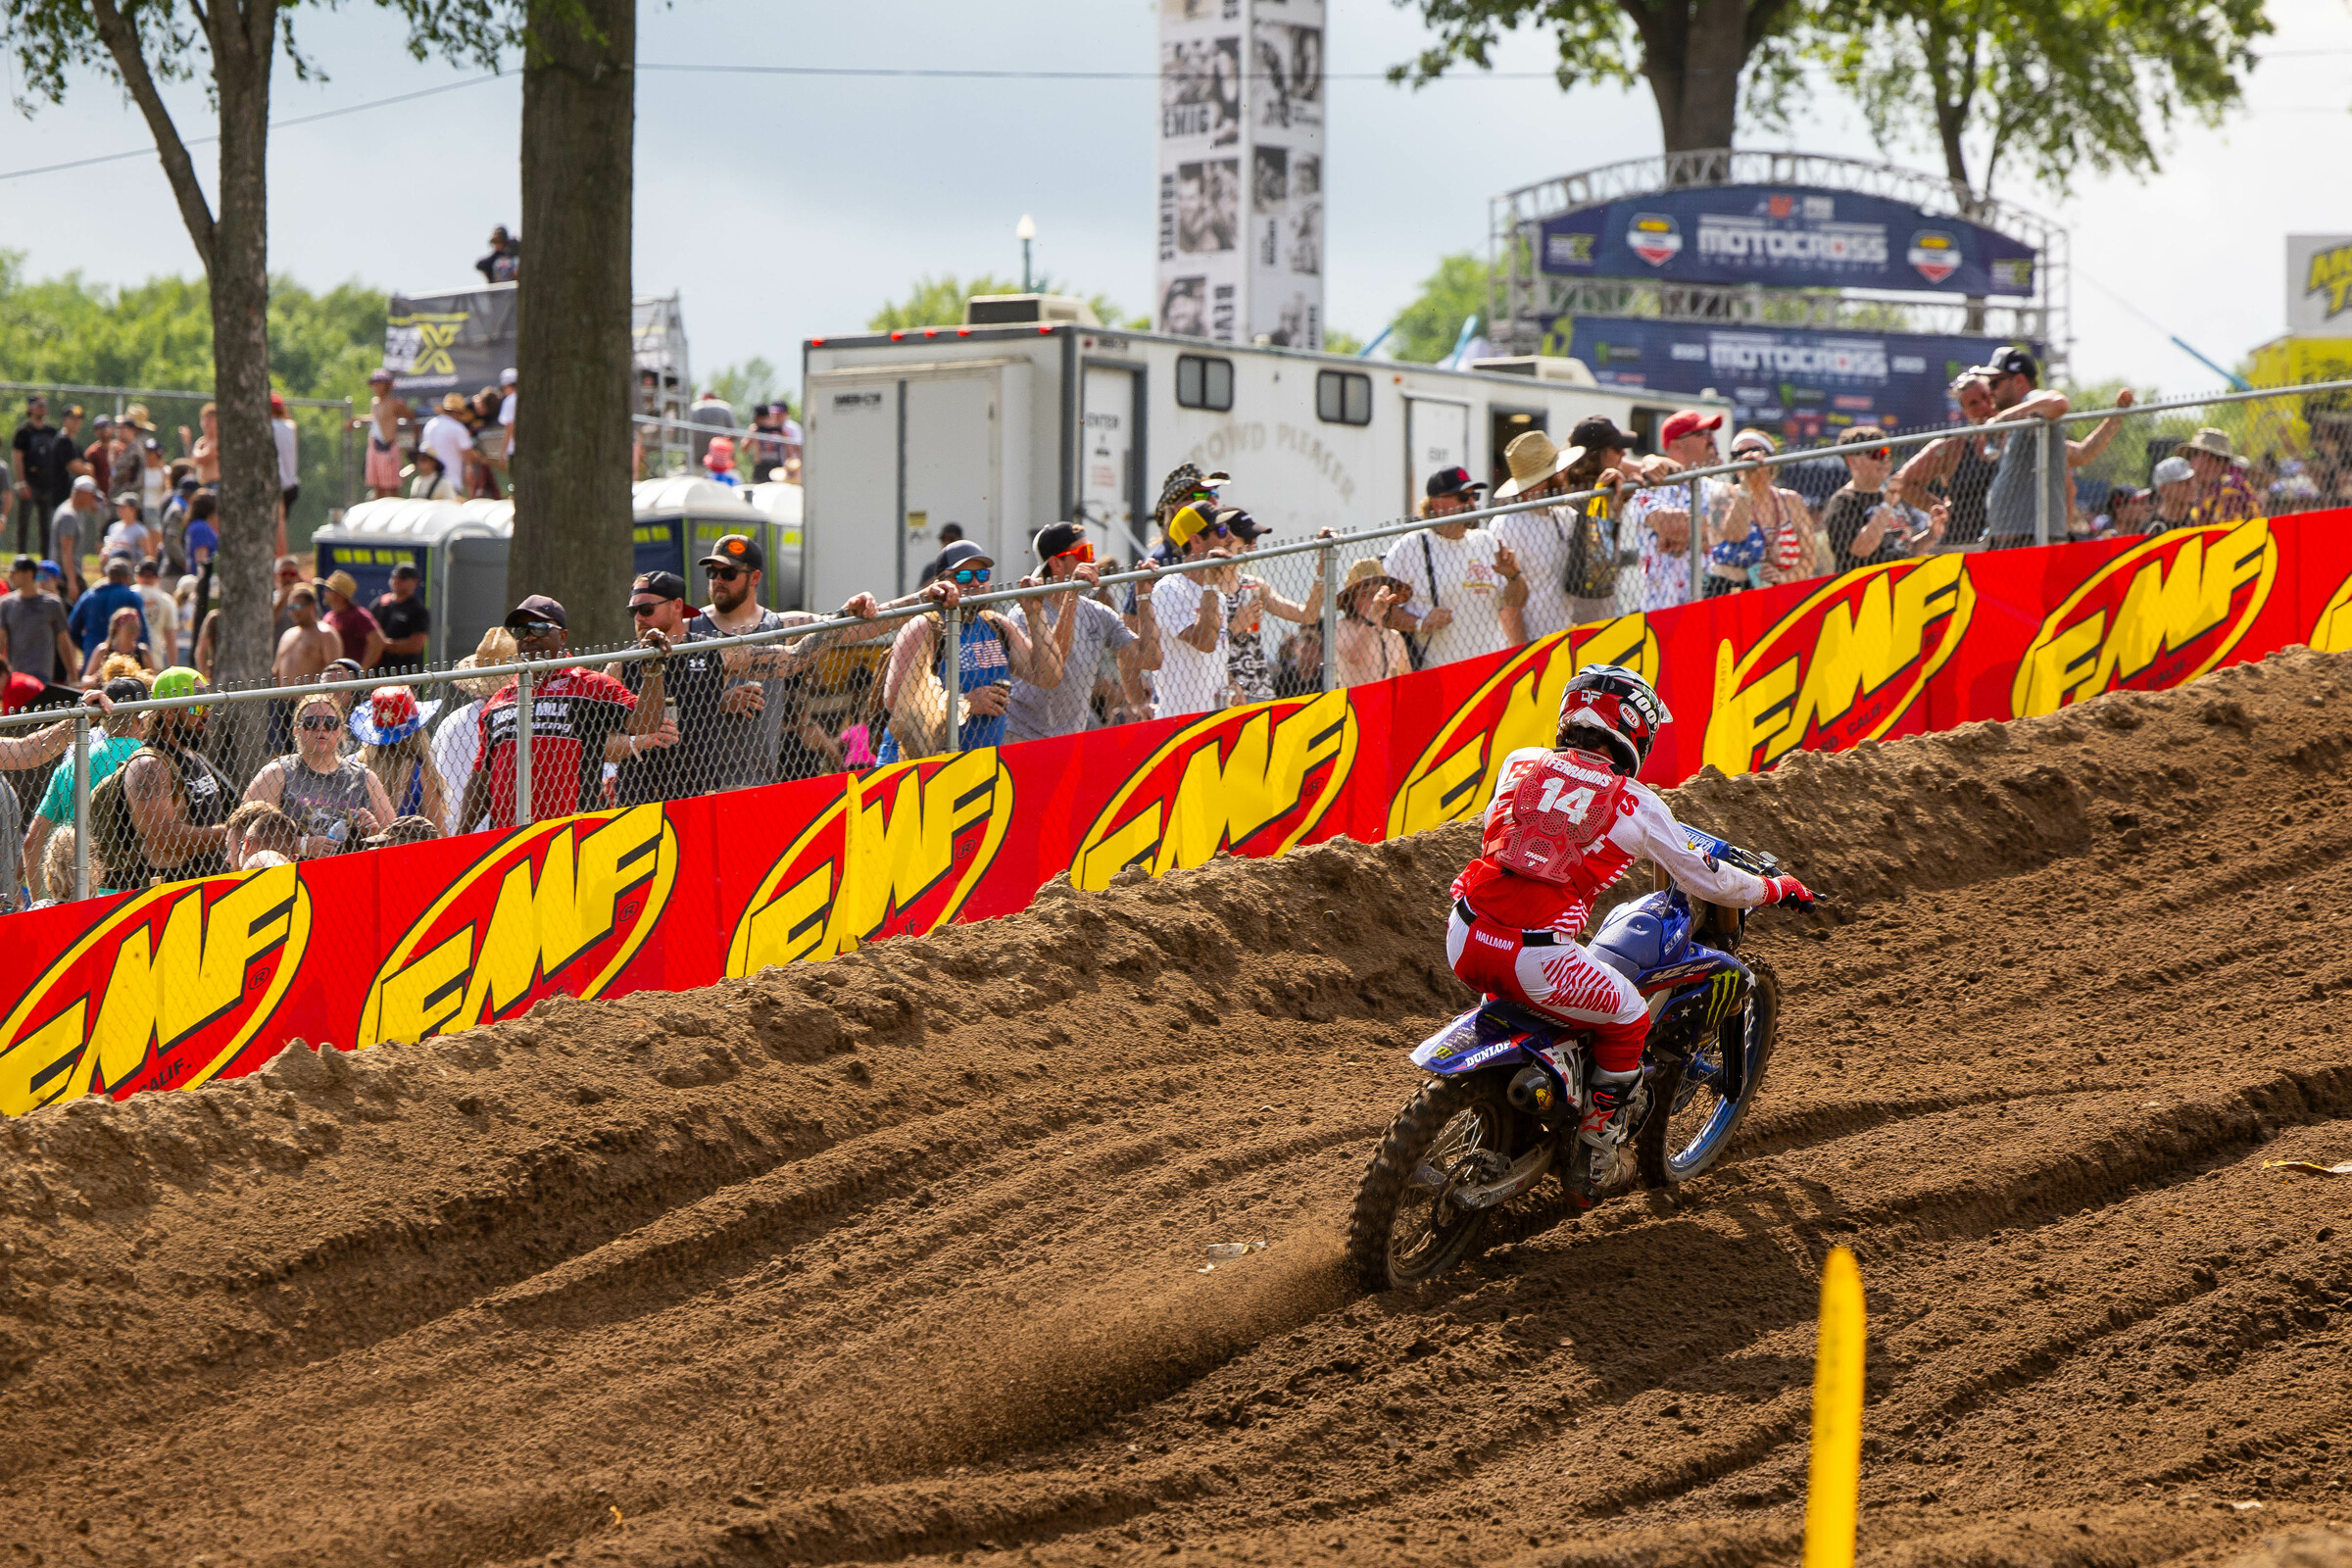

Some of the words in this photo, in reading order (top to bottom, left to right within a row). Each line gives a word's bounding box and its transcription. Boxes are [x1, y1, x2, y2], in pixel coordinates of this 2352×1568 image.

[1697, 225, 1888, 266] MOTOCROSS
[1709, 343, 1889, 377] MOTOCROSS
[1621, 706, 1639, 726] BELL
[1545, 758, 1614, 788] FERRANDIS
[1536, 776, 1597, 826] 14
[1524, 851, 1549, 864] THOR
[1475, 929, 1515, 952] HALLMAN
[1542, 987, 1622, 1015] HALLMAN
[1464, 1040, 1512, 1068] DUNLOP
